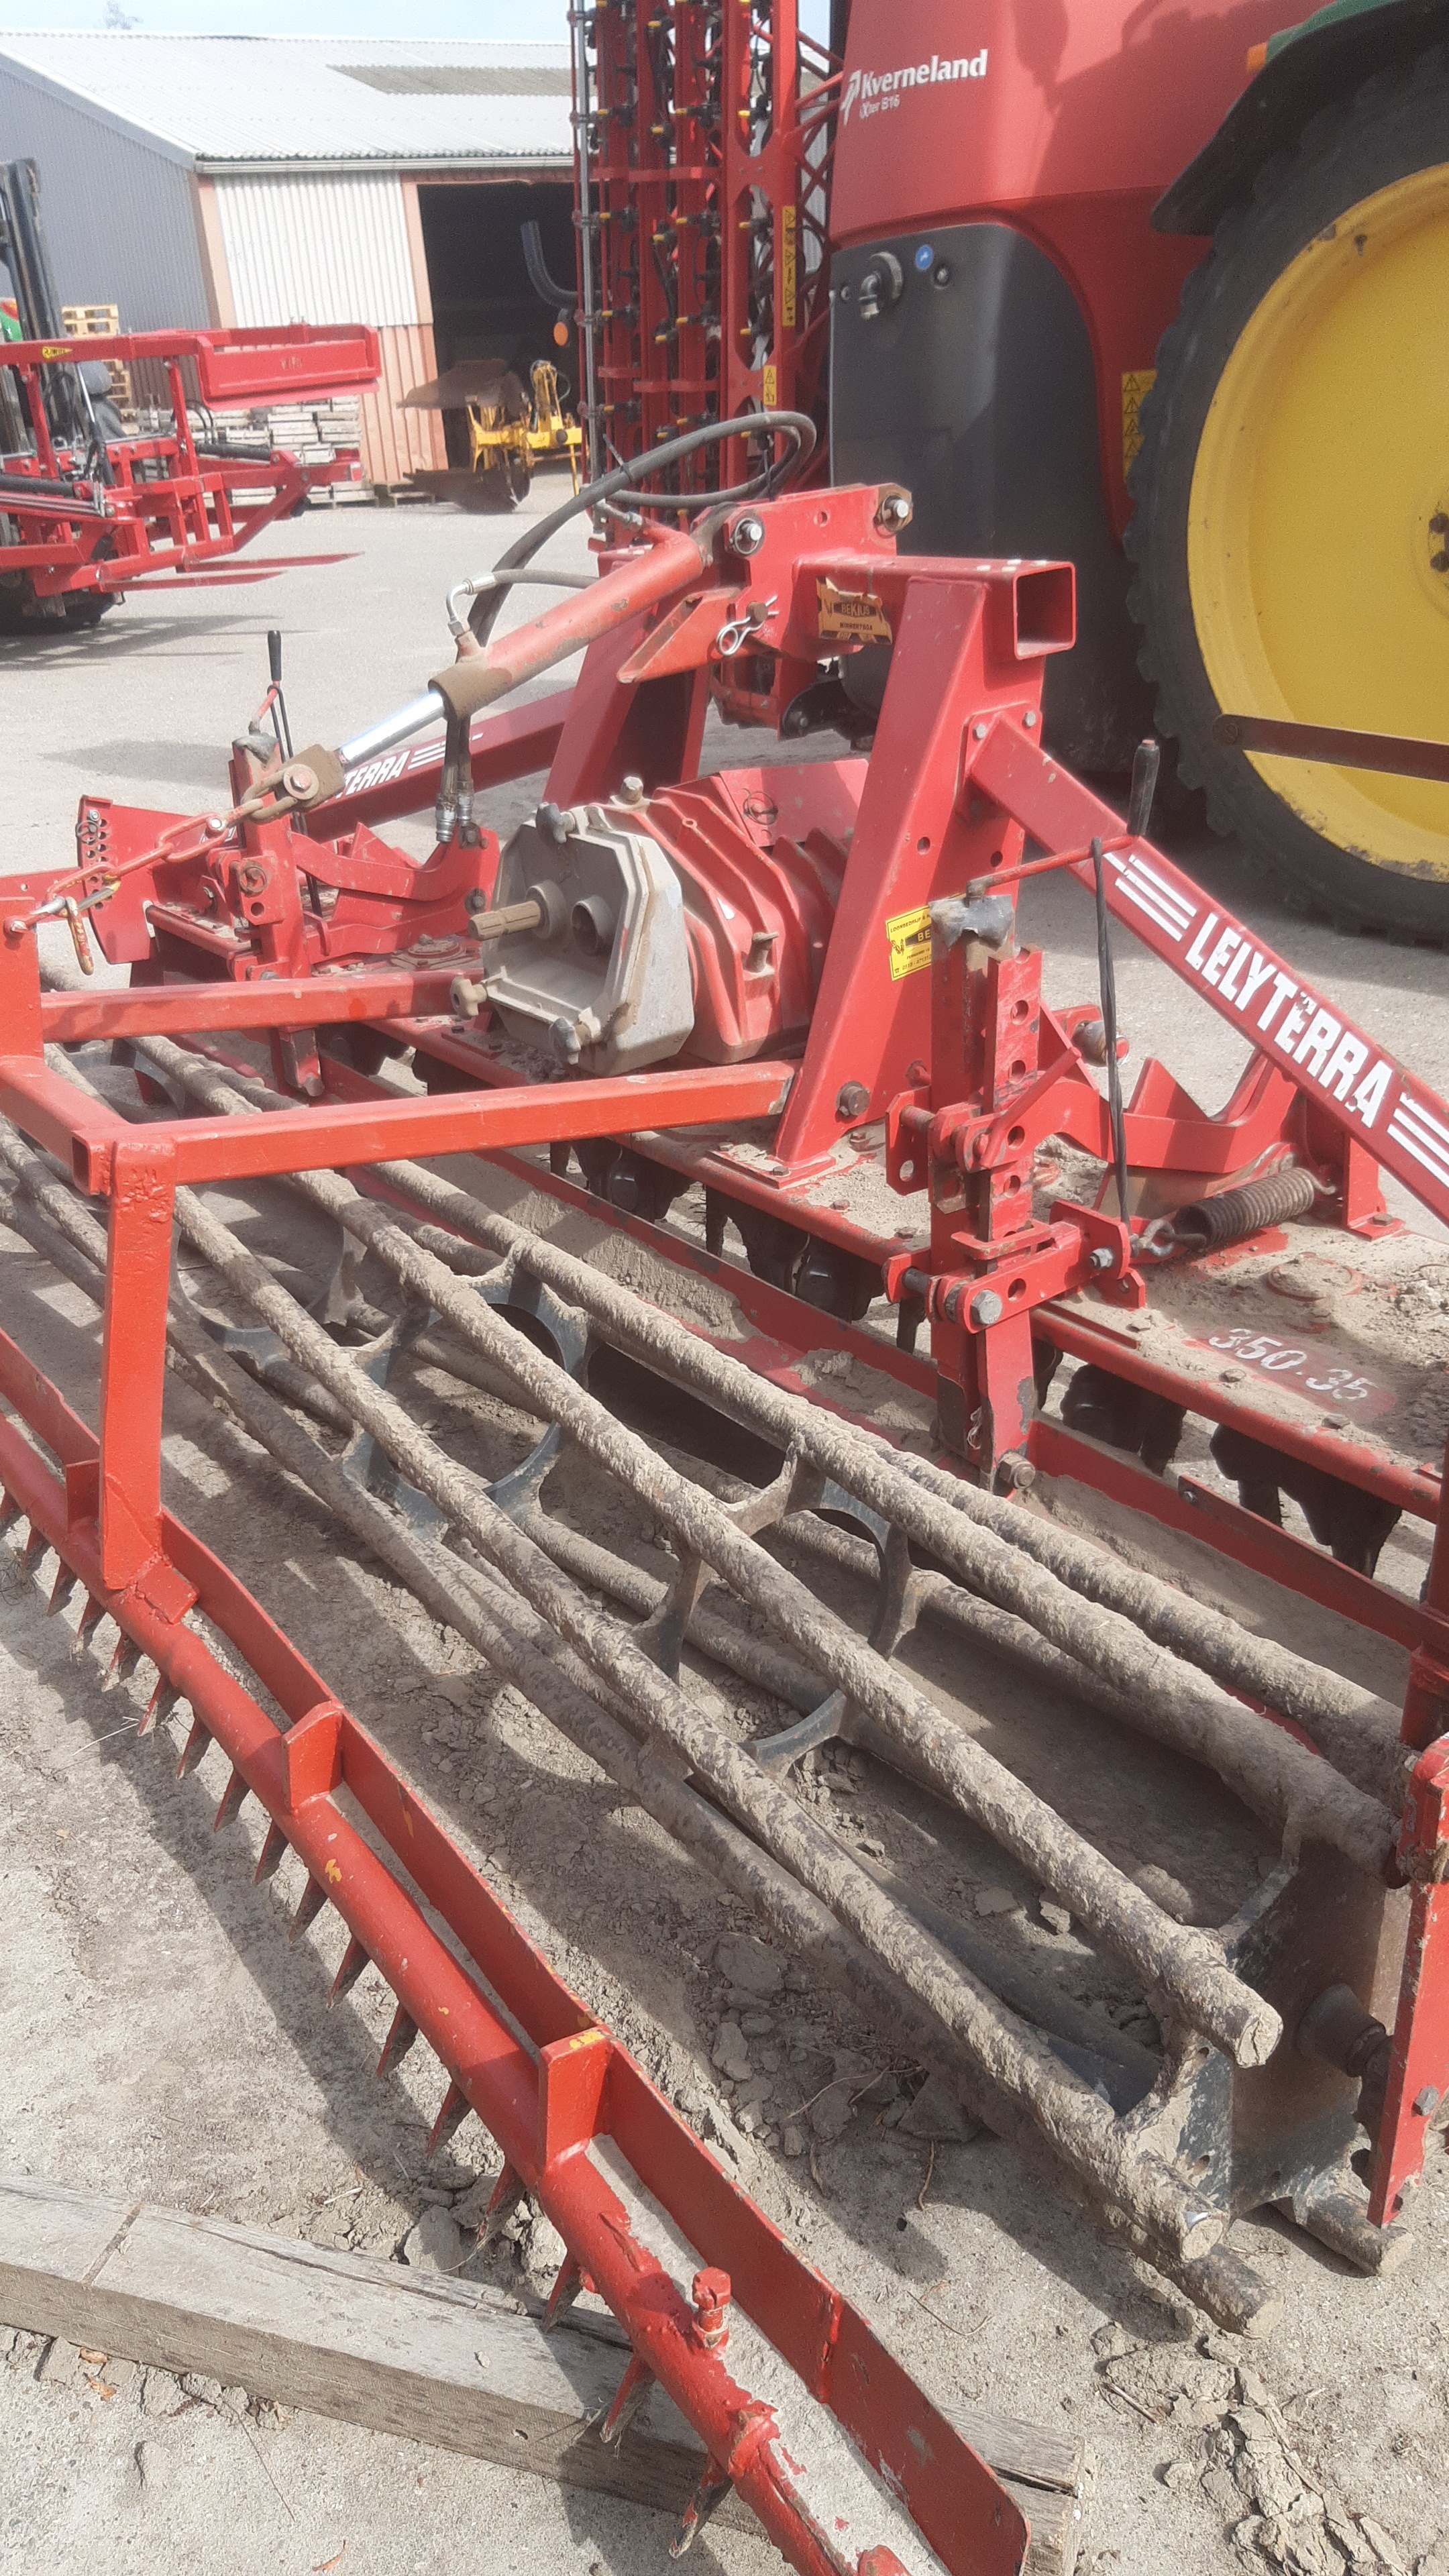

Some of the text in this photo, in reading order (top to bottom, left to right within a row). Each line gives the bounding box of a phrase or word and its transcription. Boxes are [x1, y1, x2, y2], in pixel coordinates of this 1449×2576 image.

[861, 48, 989, 99] Kverneland
[841, 604, 870, 617] BEKIUS
[335, 750, 411, 799] TERRA
[917, 929, 931, 942] BE
[1185, 912, 1393, 1128] LELYTERRA
